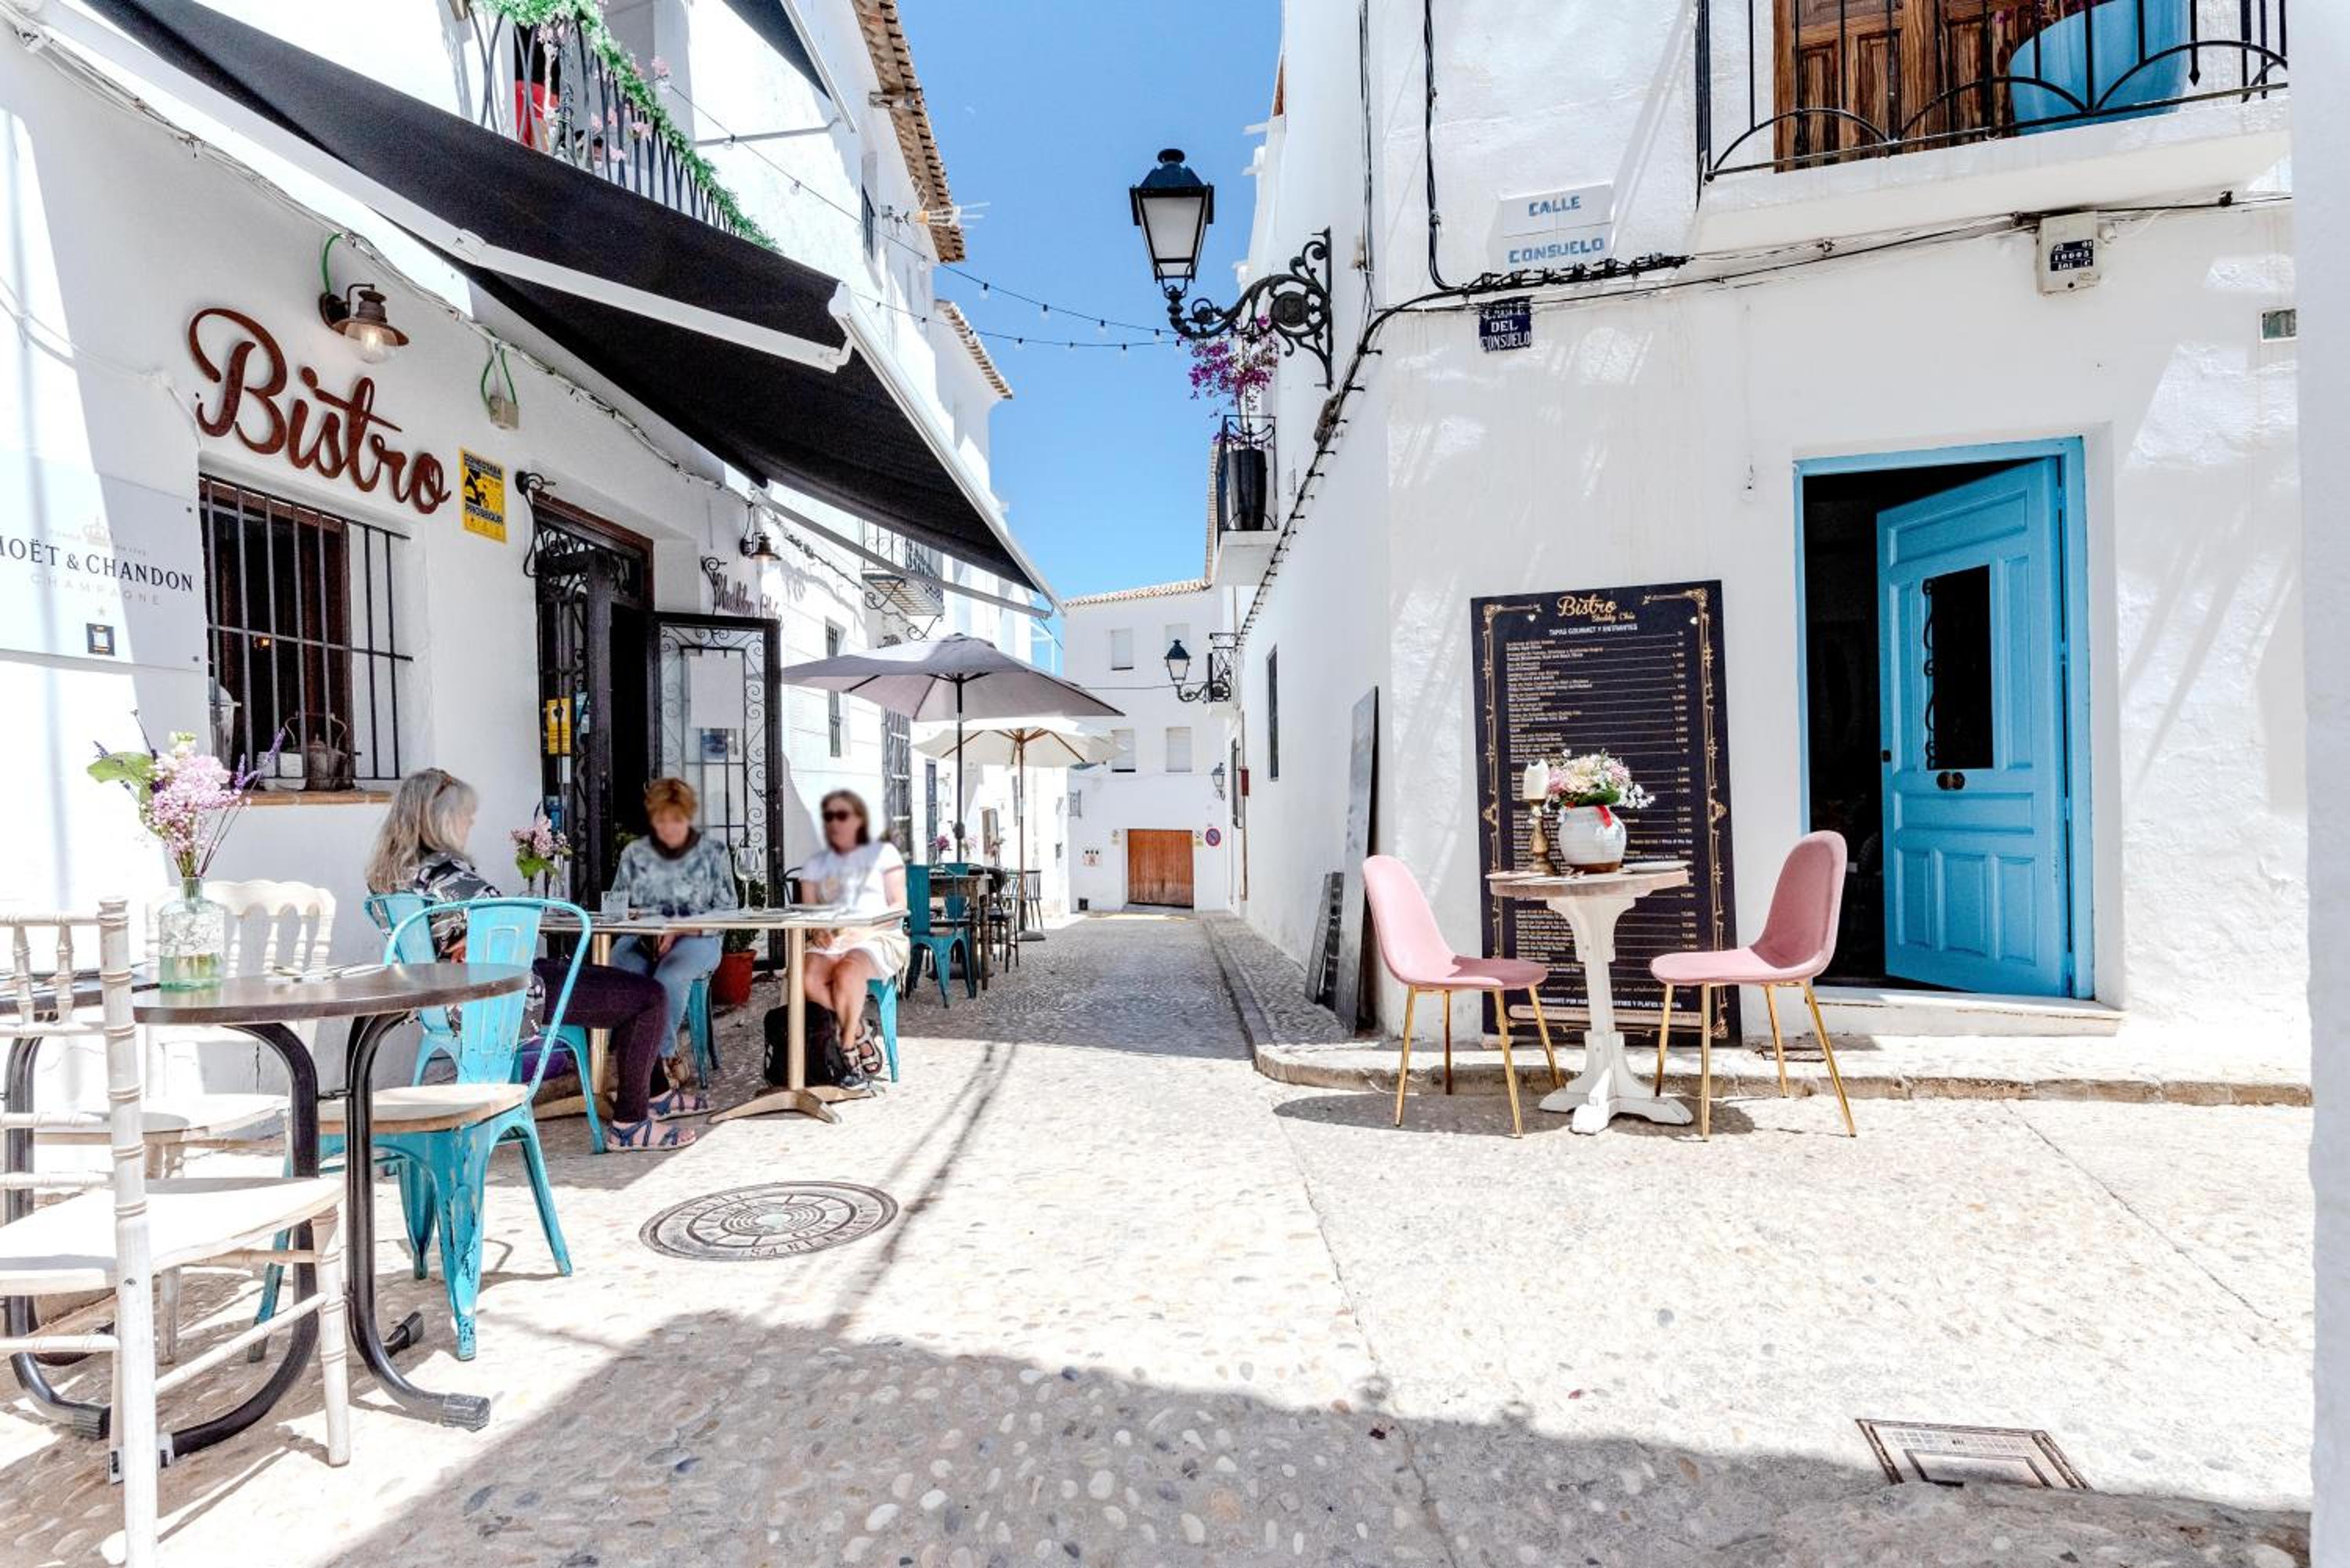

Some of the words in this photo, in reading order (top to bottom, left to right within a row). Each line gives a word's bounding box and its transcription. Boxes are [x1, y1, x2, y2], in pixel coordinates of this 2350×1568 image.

[1528, 196, 1581, 217] CALLE
[1508, 237, 1605, 265] CONSUELO
[1491, 320, 1519, 333] DEL
[1480, 331, 1530, 352] CONSUELO
[188, 308, 452, 515] Bistro
[67, 553, 80, 571] &
[85, 554, 194, 592] CHANDON
[30, 573, 161, 606] CHAMPAGNE
[1556, 593, 1618, 617] Bistro
